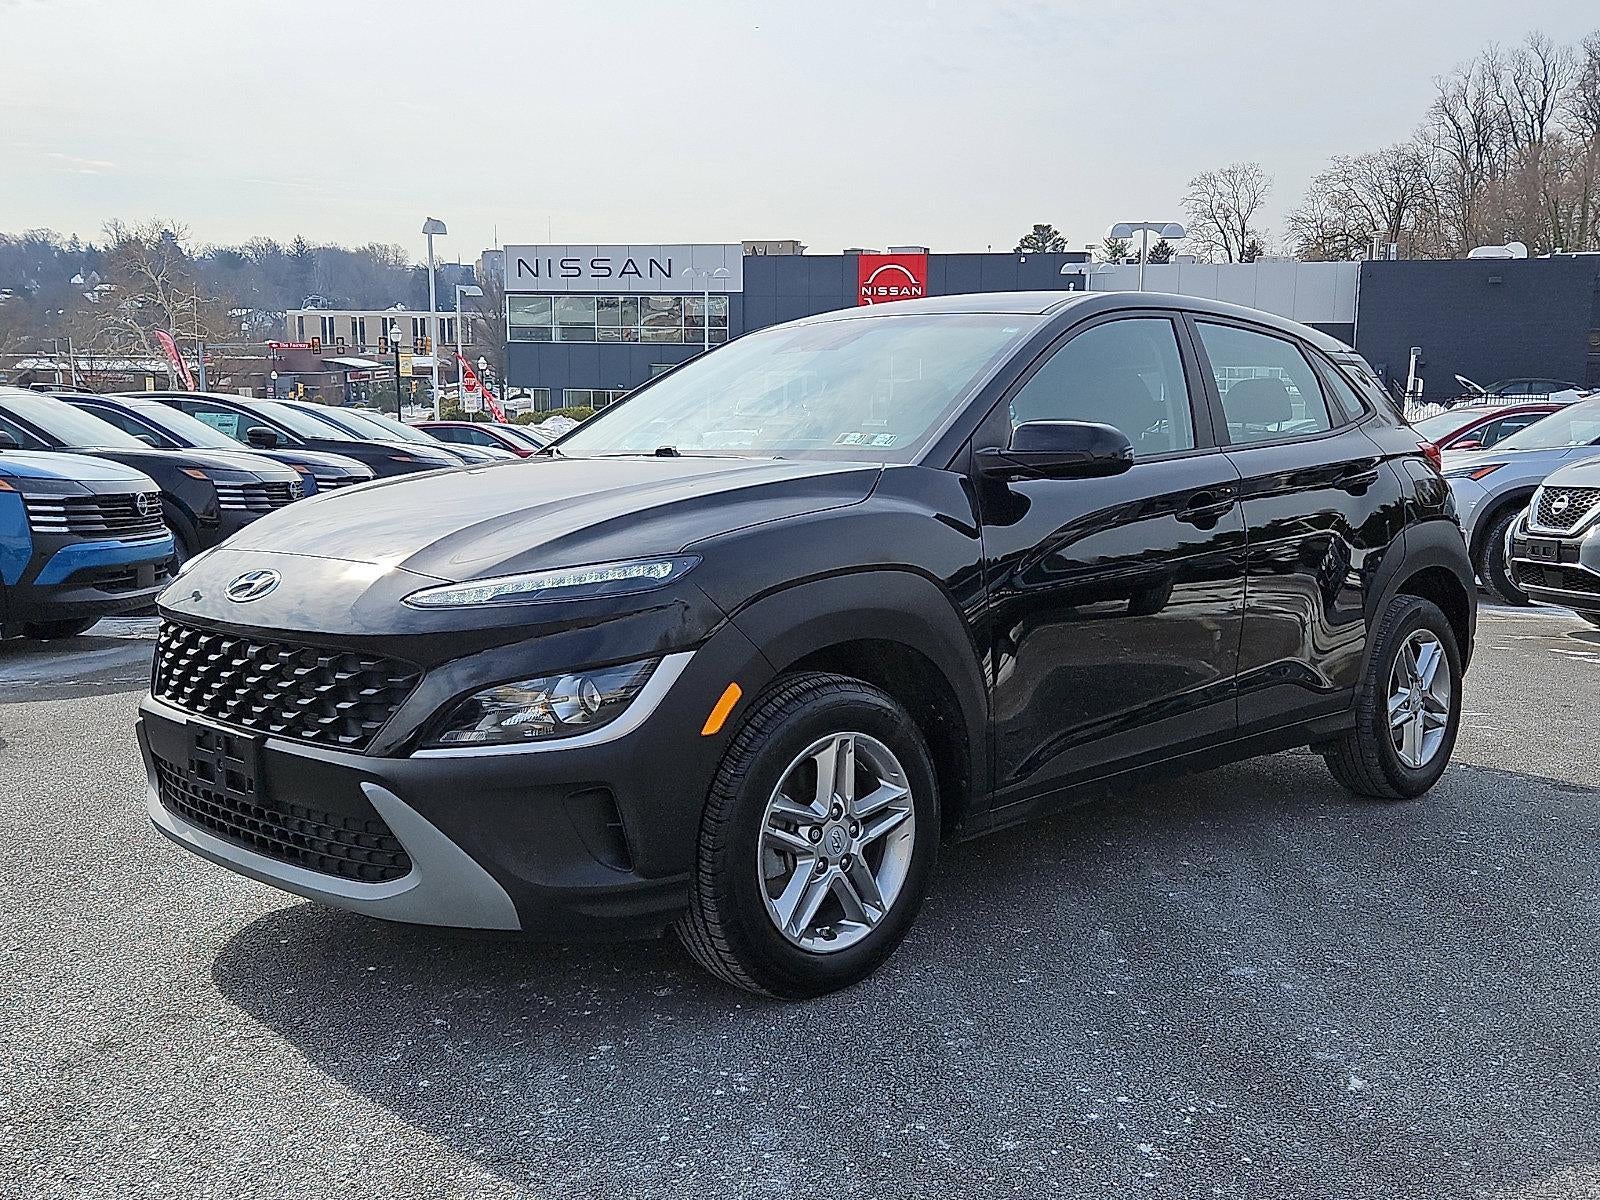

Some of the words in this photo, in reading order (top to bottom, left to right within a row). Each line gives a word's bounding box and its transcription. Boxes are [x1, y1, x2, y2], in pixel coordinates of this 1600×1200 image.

[517, 258, 672, 278] NISSAN
[861, 286, 922, 296] NISSAN
[464, 378, 476, 386] STOP
